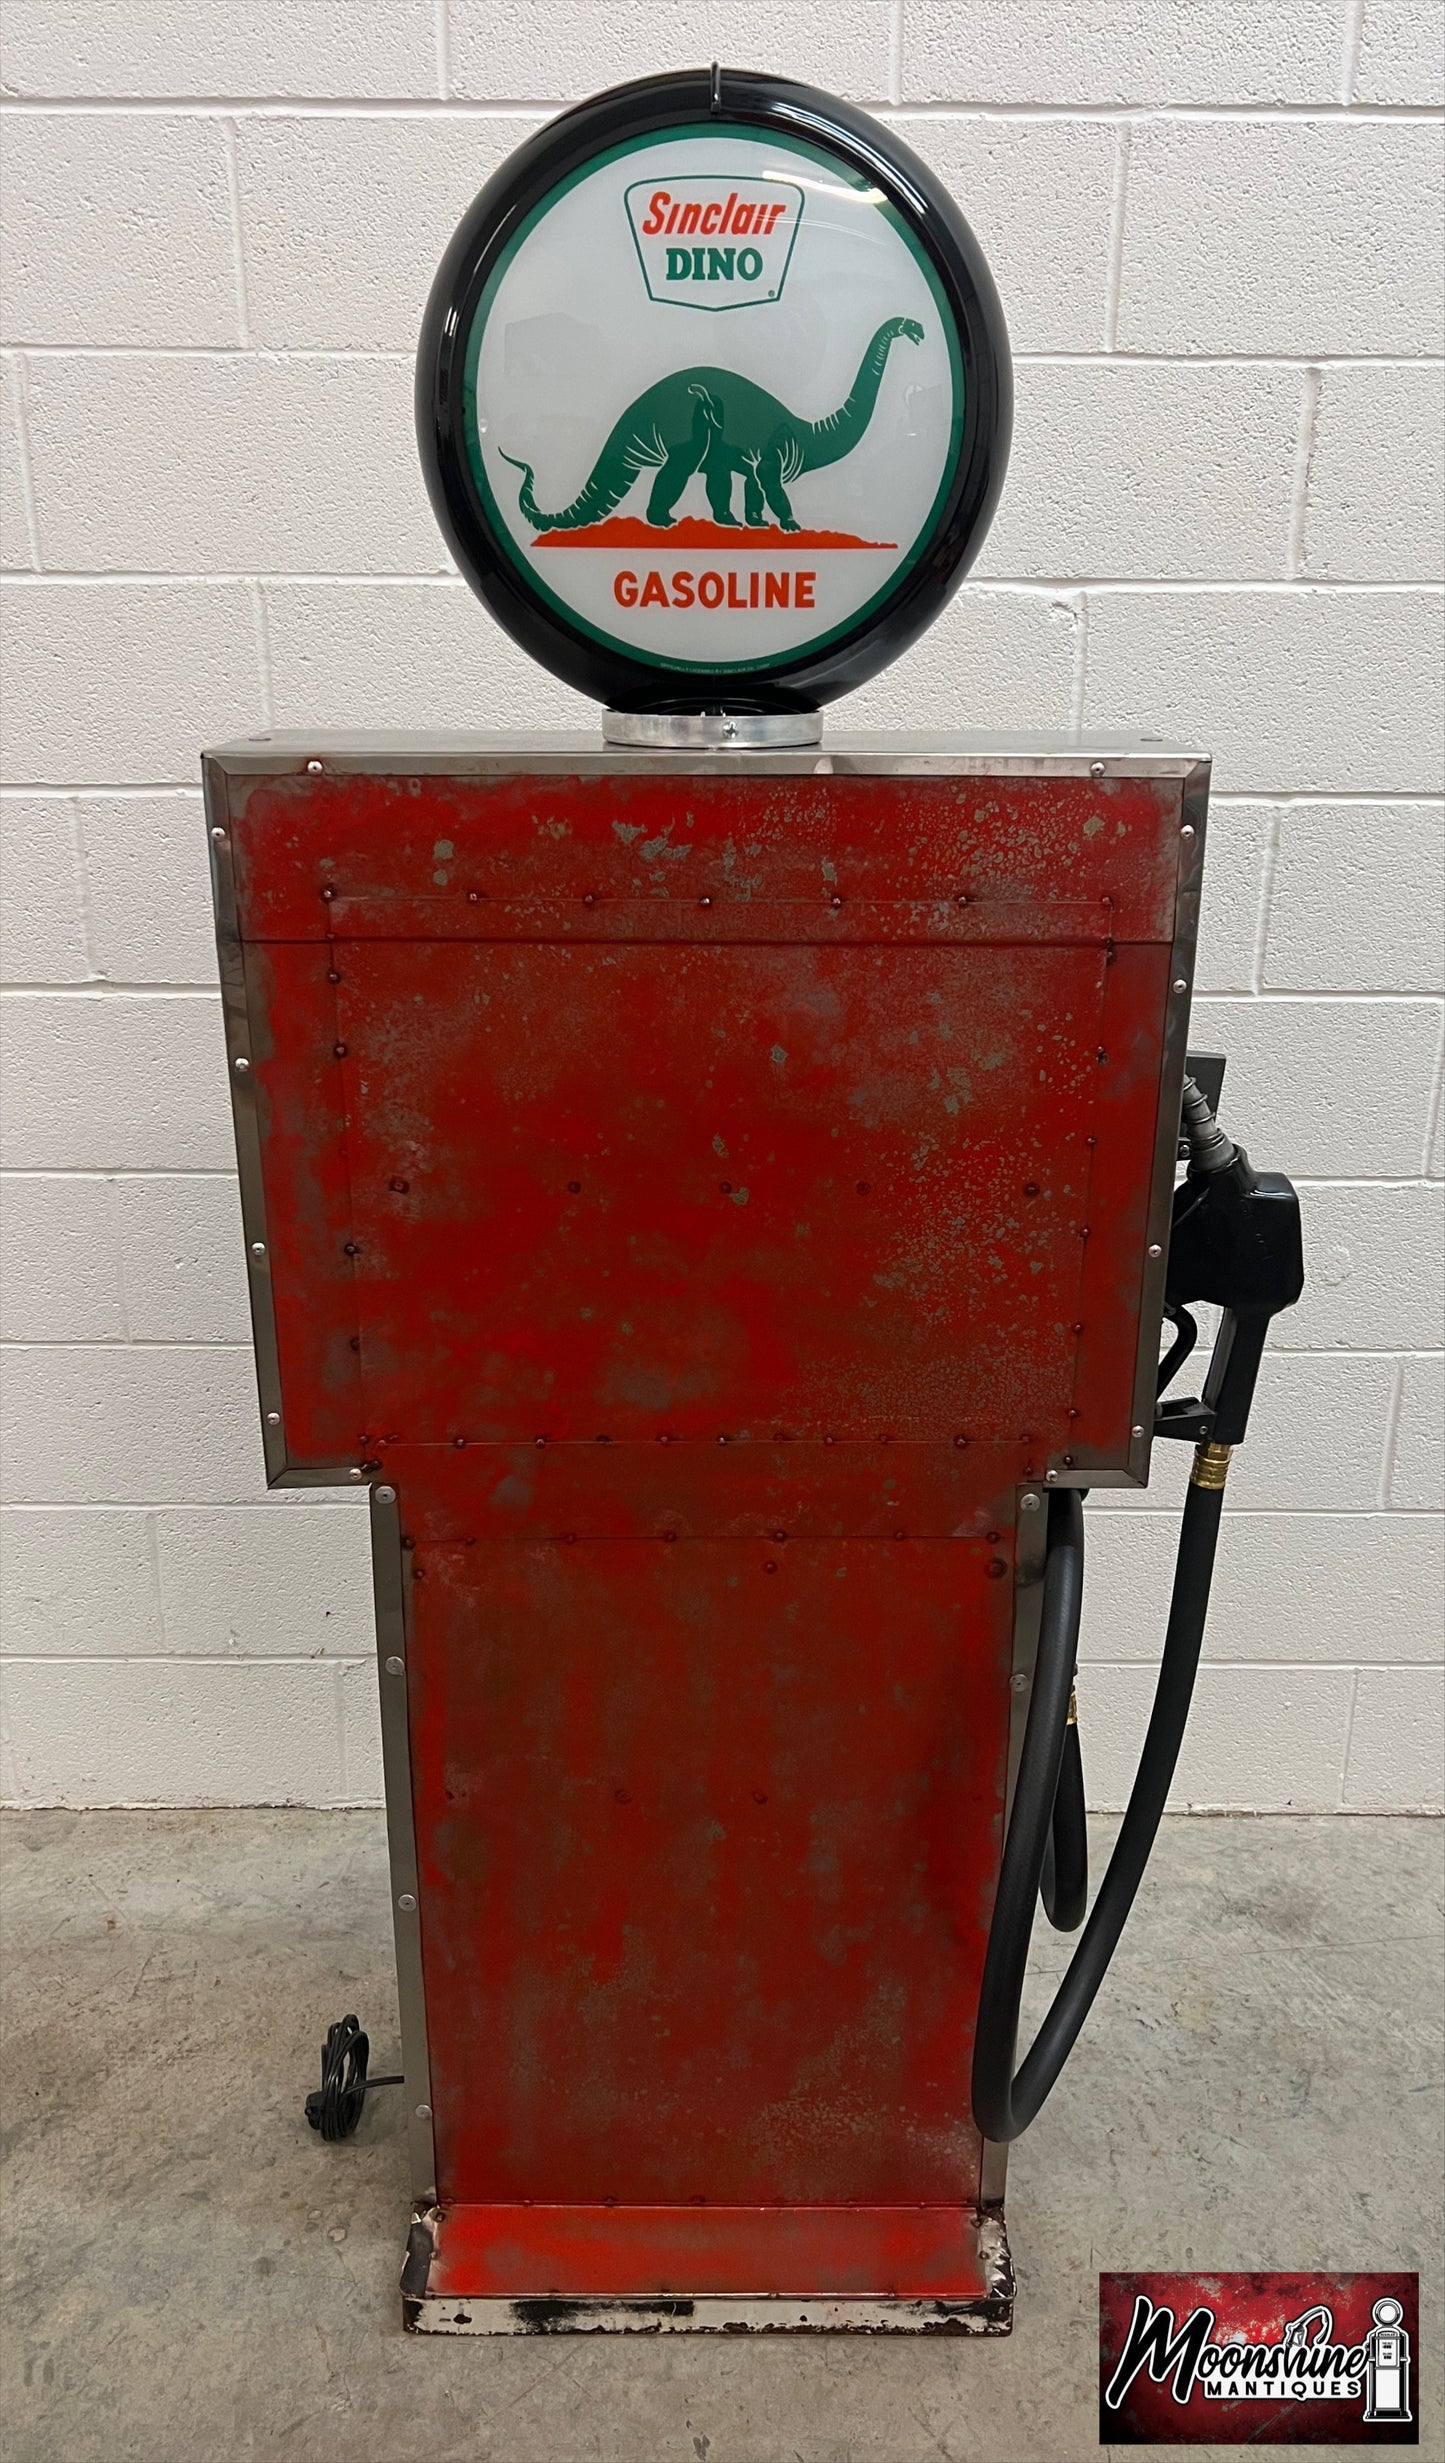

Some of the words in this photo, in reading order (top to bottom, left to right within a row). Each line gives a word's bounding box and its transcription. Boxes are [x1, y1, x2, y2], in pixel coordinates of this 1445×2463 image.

[642, 191, 786, 236] Sinclair
[665, 247, 764, 281] DINO
[613, 571, 816, 609] GASOLINE
